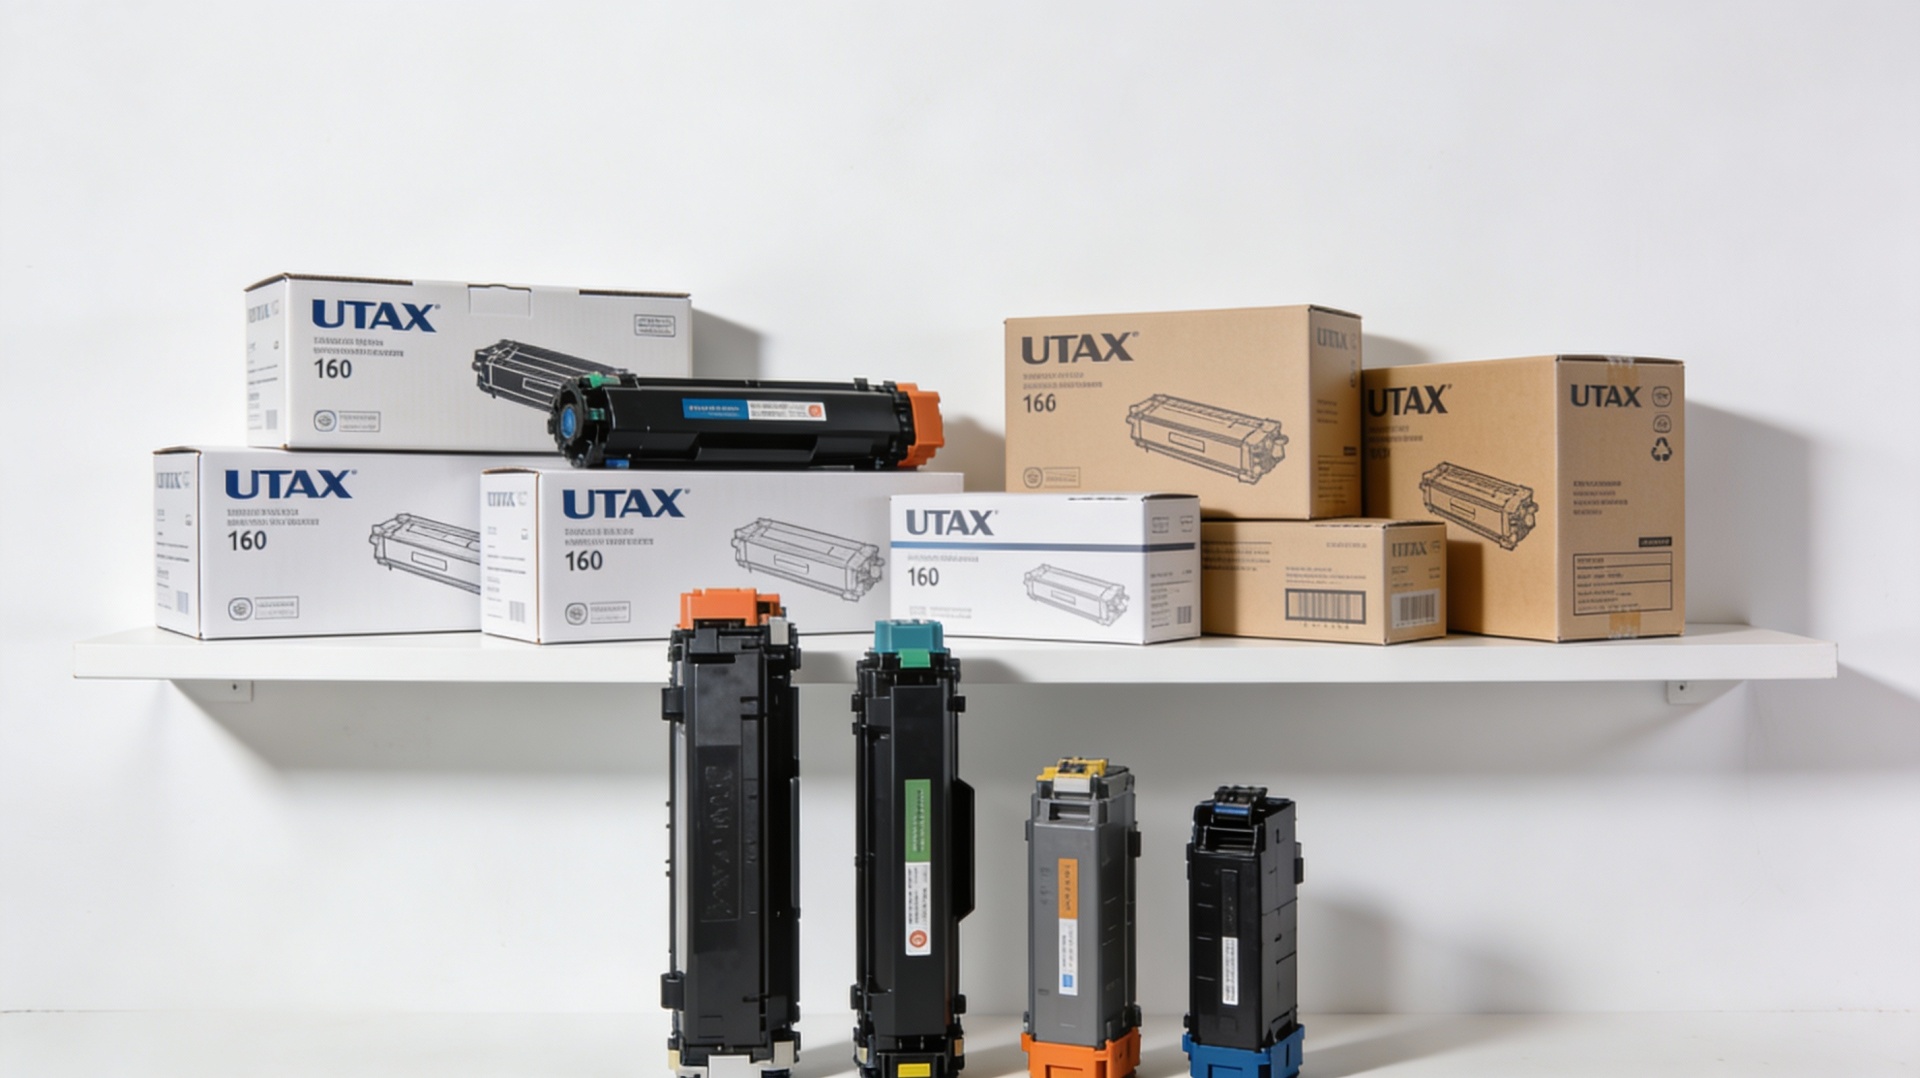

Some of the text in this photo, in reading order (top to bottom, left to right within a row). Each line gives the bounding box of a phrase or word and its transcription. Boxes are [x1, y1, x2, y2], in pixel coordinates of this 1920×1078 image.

[312, 299, 435, 332] UTAX
[1022, 332, 1134, 364] UTAX
[314, 359, 352, 379] 160
[1368, 384, 1448, 418] UTAX
[1570, 385, 1641, 408] UTAX
[225, 470, 352, 499] UTAX
[562, 488, 685, 519] UTAX
[906, 509, 994, 536] UTAX
[228, 530, 267, 551] 160
[565, 550, 604, 571] 160
[907, 567, 940, 587] 160
